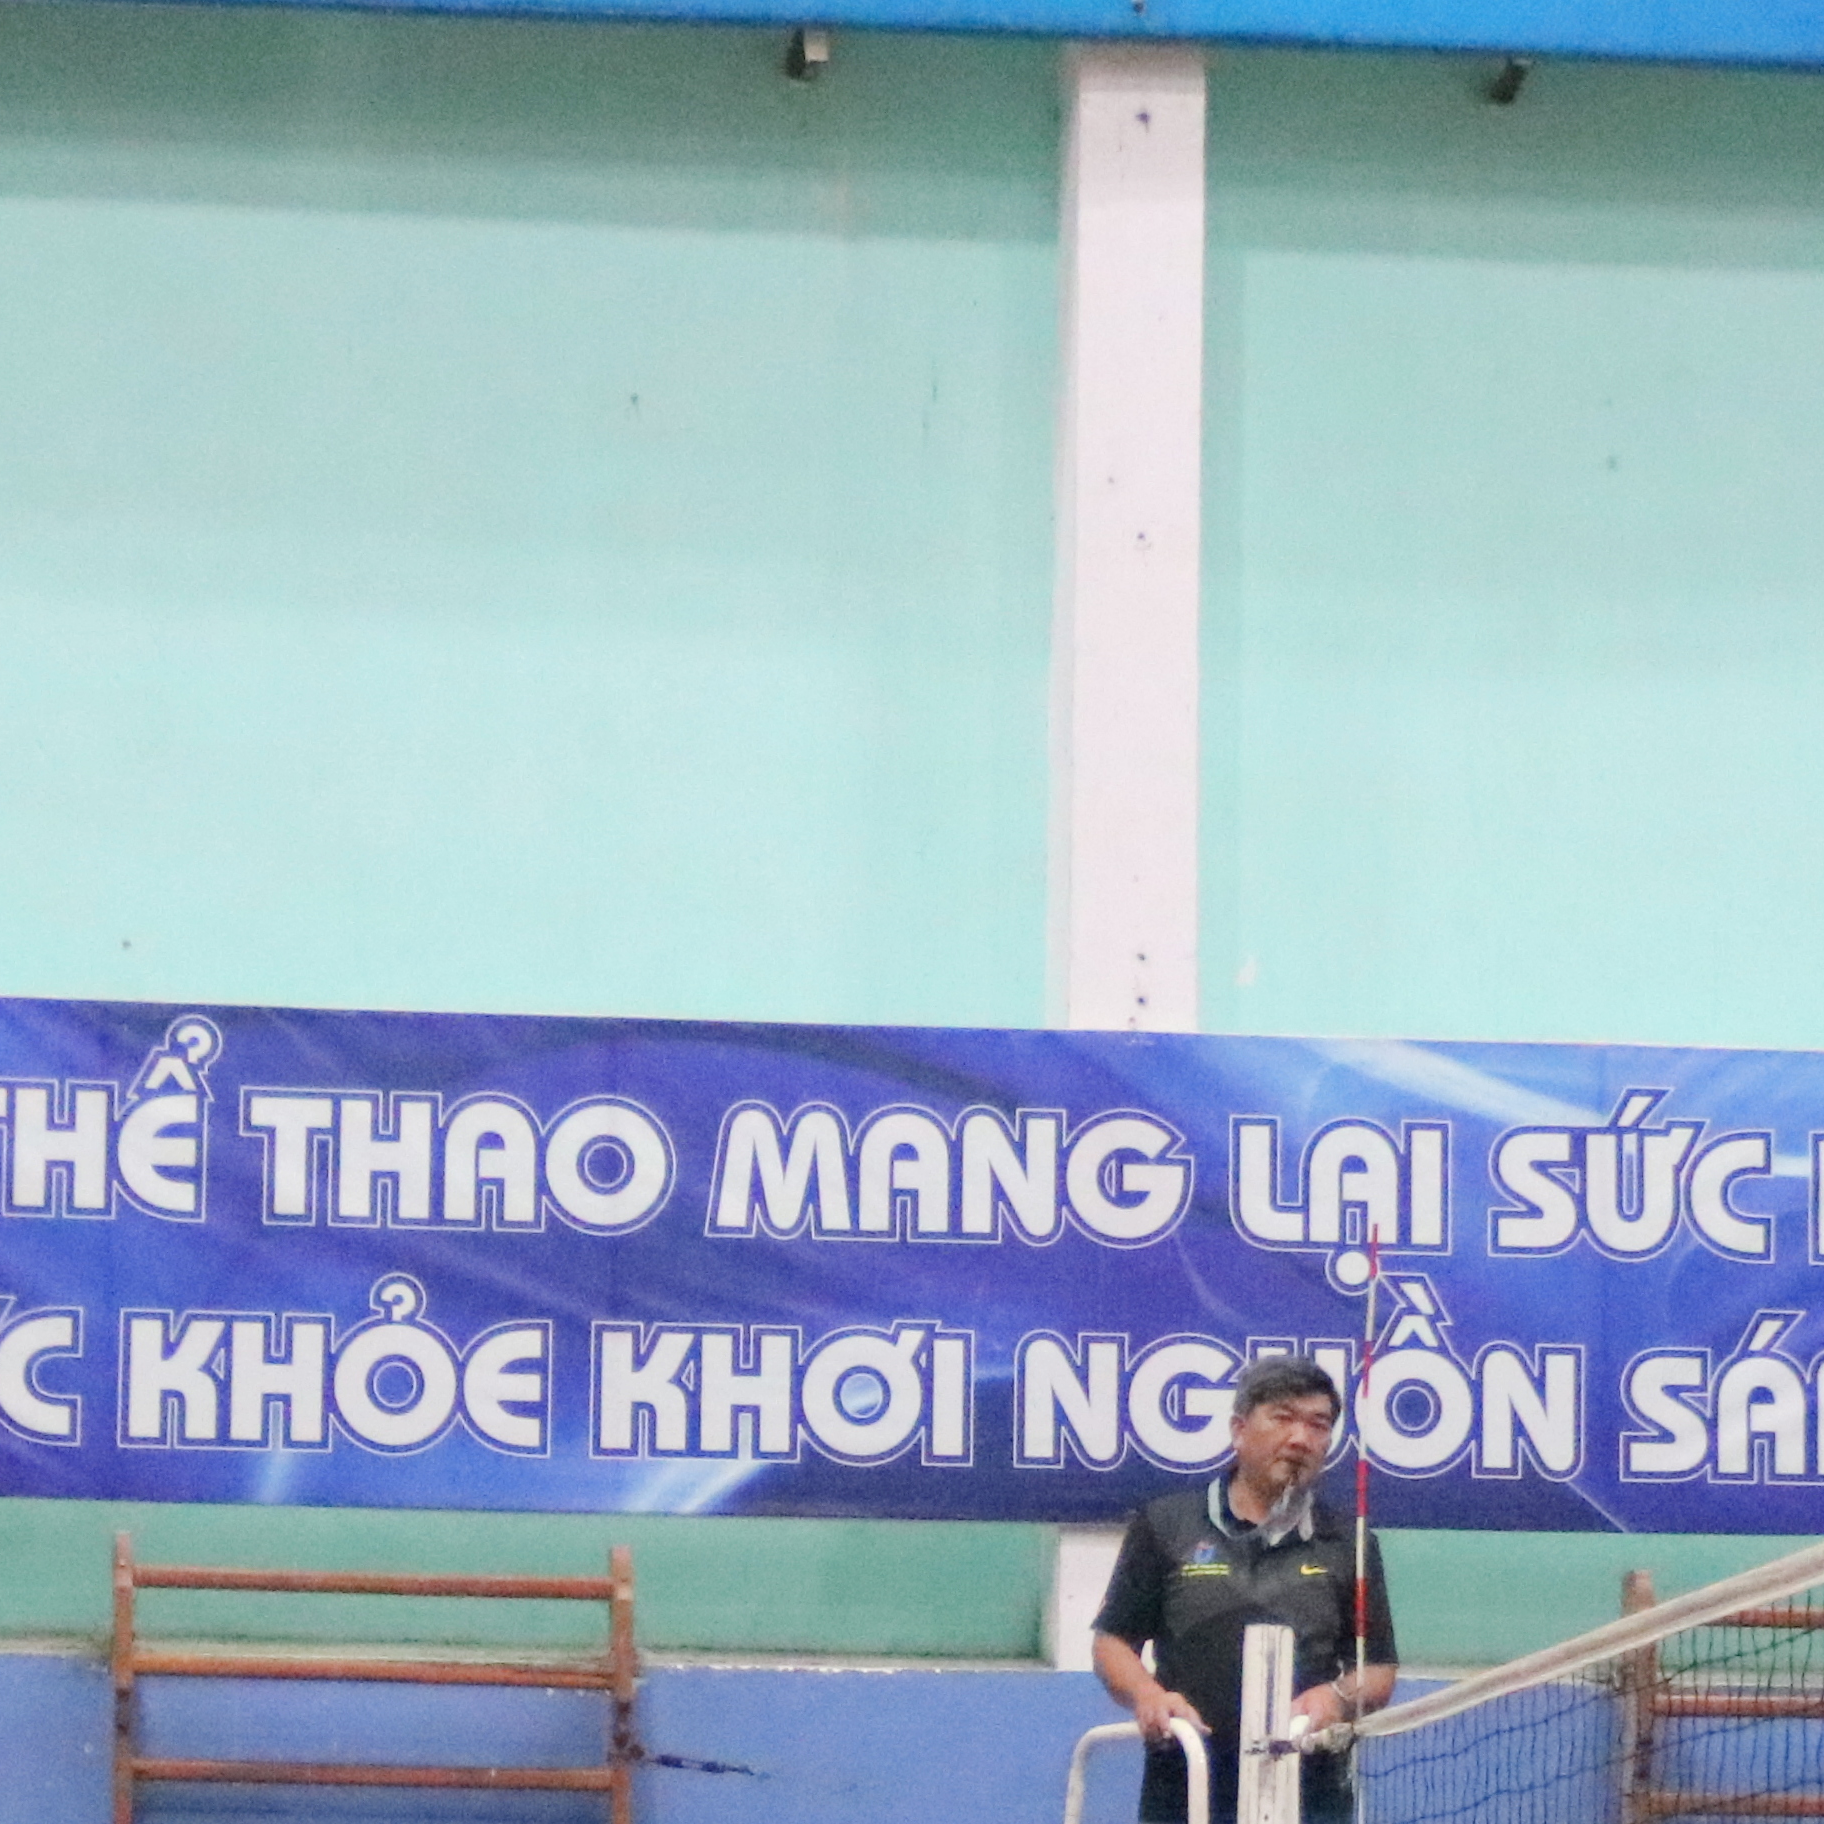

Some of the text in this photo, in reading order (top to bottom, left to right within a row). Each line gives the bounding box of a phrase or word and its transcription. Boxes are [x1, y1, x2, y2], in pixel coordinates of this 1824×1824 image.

[241, 1086, 675, 1236] THAO
[705, 1098, 1195, 1250] MANG
[1230, 1116, 1451, 1298] LẠI
[1489, 1088, 1777, 1264] SỨC
[119, 1276, 551, 1454] KHỎE
[589, 1320, 973, 1466] KHƠI
